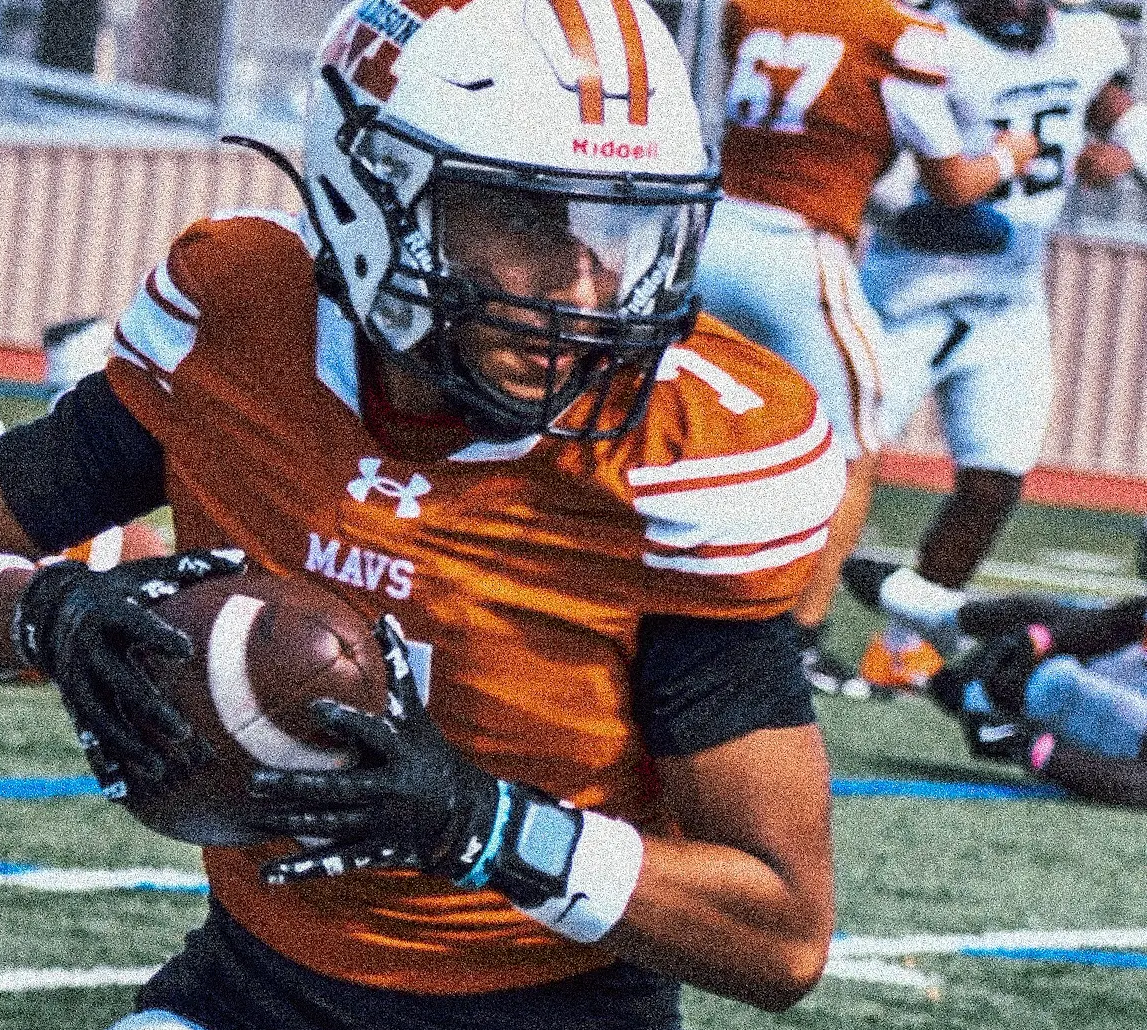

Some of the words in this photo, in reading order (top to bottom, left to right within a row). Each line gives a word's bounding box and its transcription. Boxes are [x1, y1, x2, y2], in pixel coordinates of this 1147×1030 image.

[726, 28, 845, 134] 67
[572, 138, 658, 159] Riddell
[305, 532, 415, 600] MAVS
